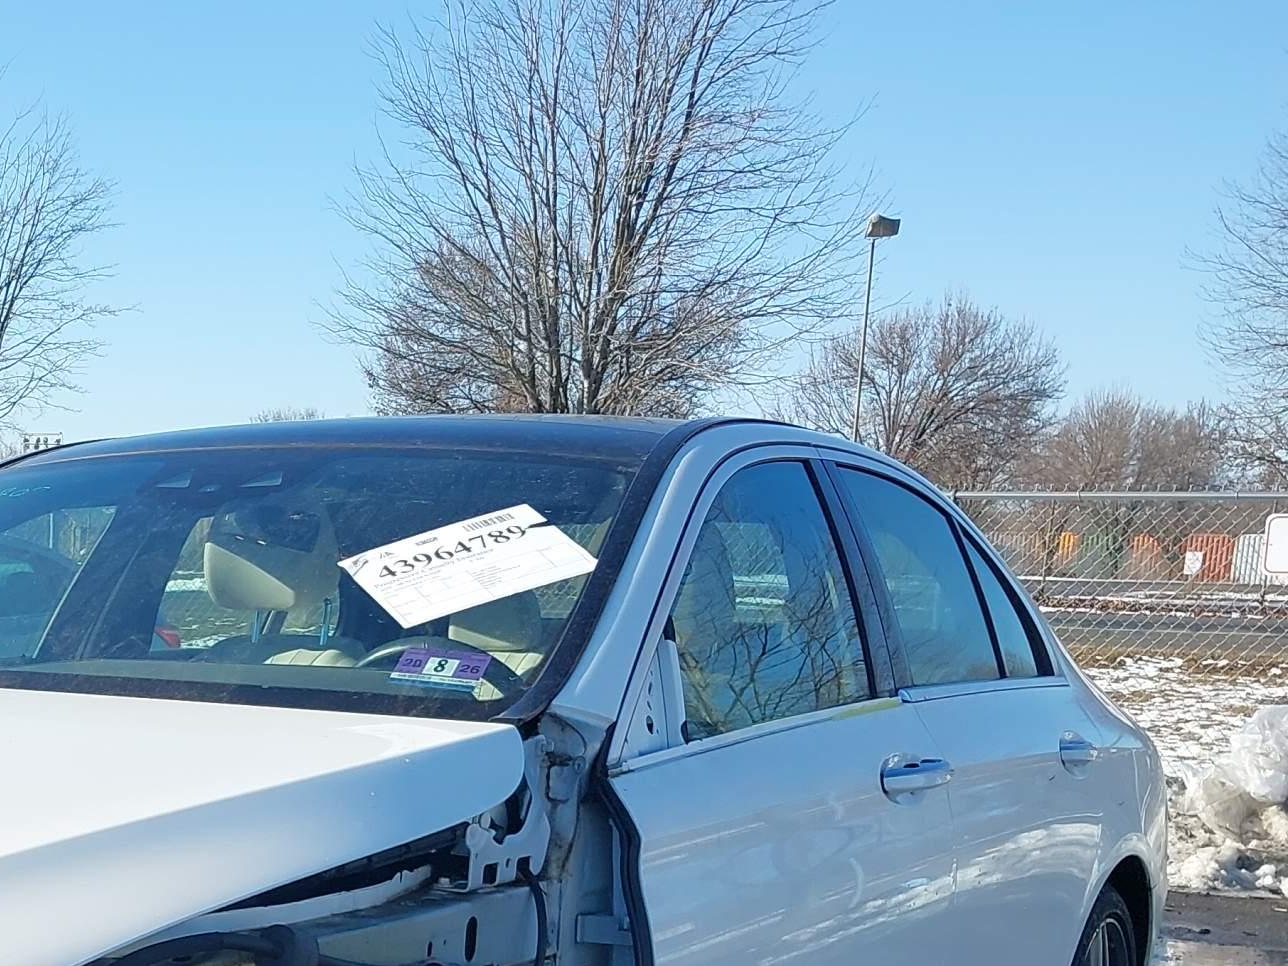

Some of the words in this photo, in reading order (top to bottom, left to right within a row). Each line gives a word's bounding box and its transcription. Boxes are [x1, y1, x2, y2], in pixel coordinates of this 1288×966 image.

[378, 525, 527, 578] 43964789
[402, 658, 423, 668] 20
[433, 659, 448, 673] 8
[458, 664, 481, 674] 26
